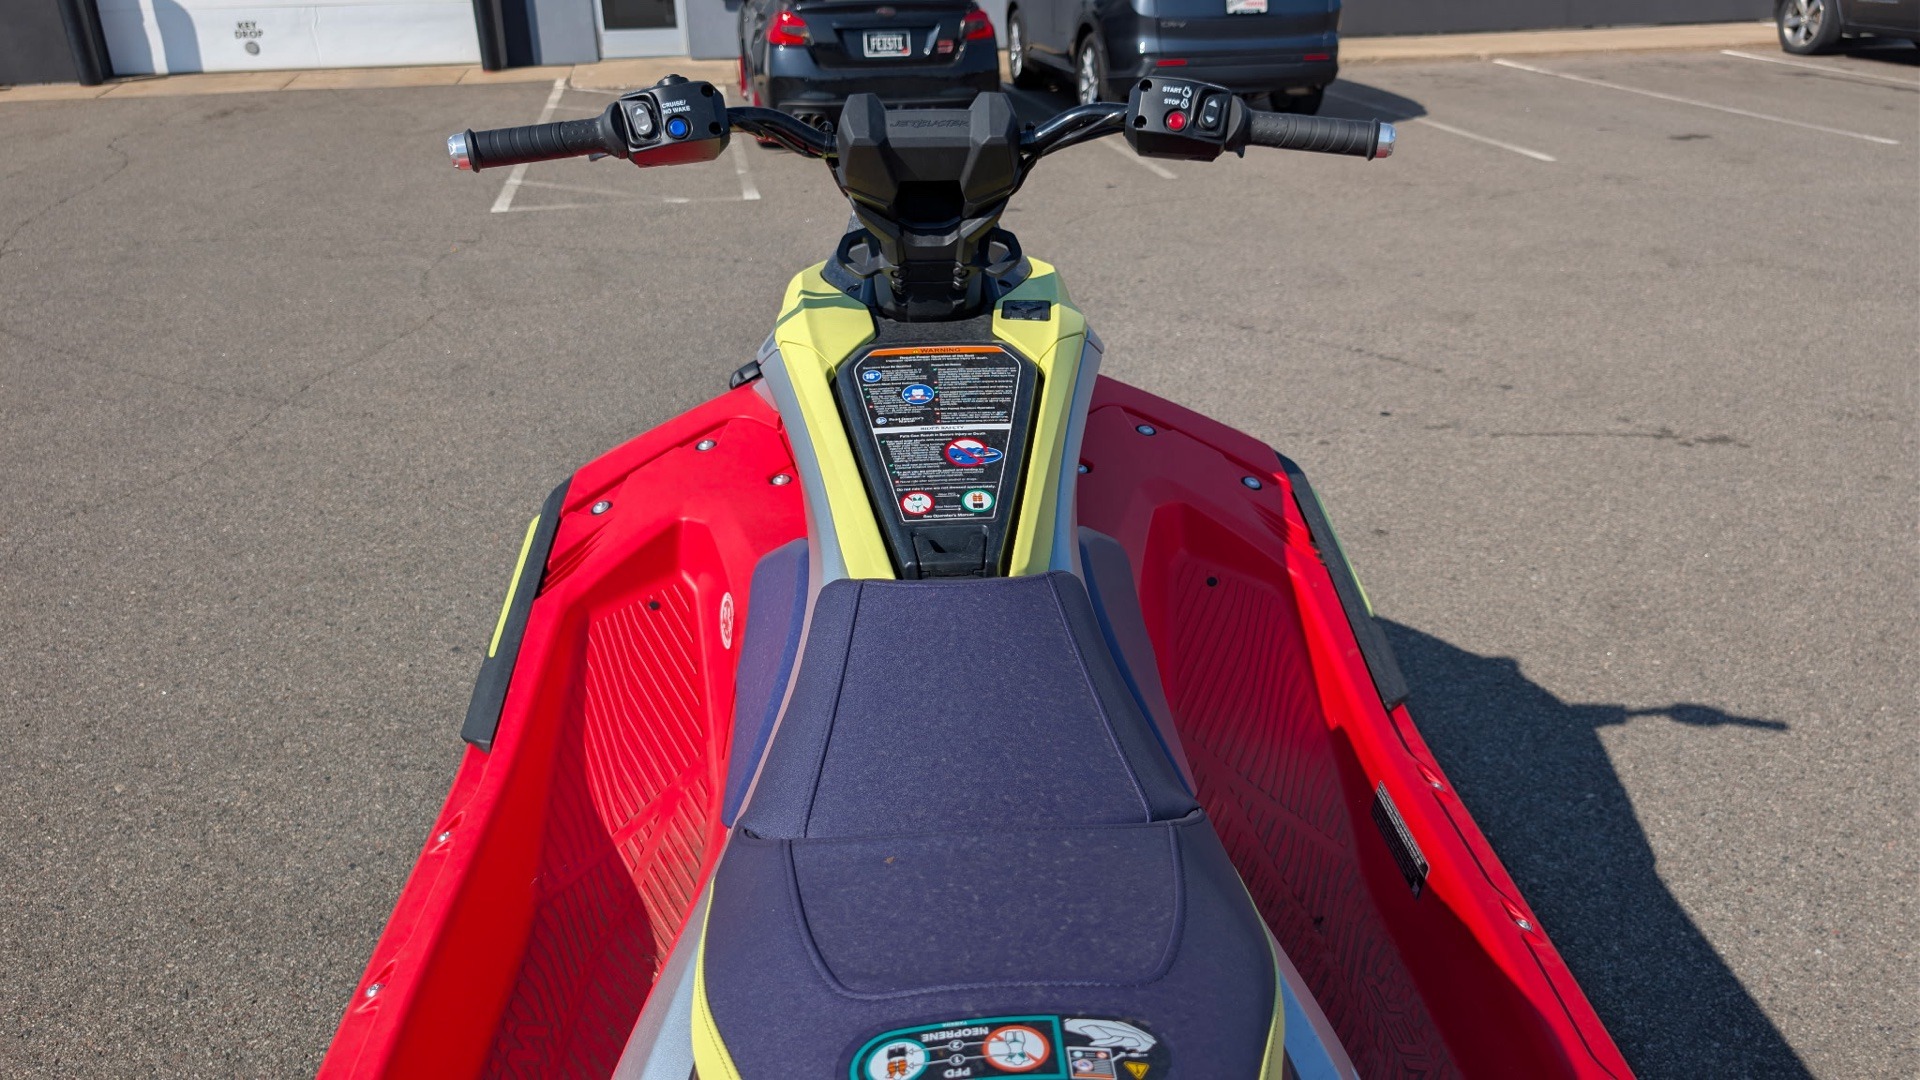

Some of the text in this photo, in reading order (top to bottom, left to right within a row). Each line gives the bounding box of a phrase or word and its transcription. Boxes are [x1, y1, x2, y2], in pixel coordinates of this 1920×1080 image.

[238, 22, 256, 30] KEY
[235, 30, 264, 38] DROP
[1162, 86, 1182, 94] START
[662, 100, 686, 108] CRUISE/
[921, 1026, 989, 1042] NEOPRENE
[944, 1067, 971, 1078] PFD
